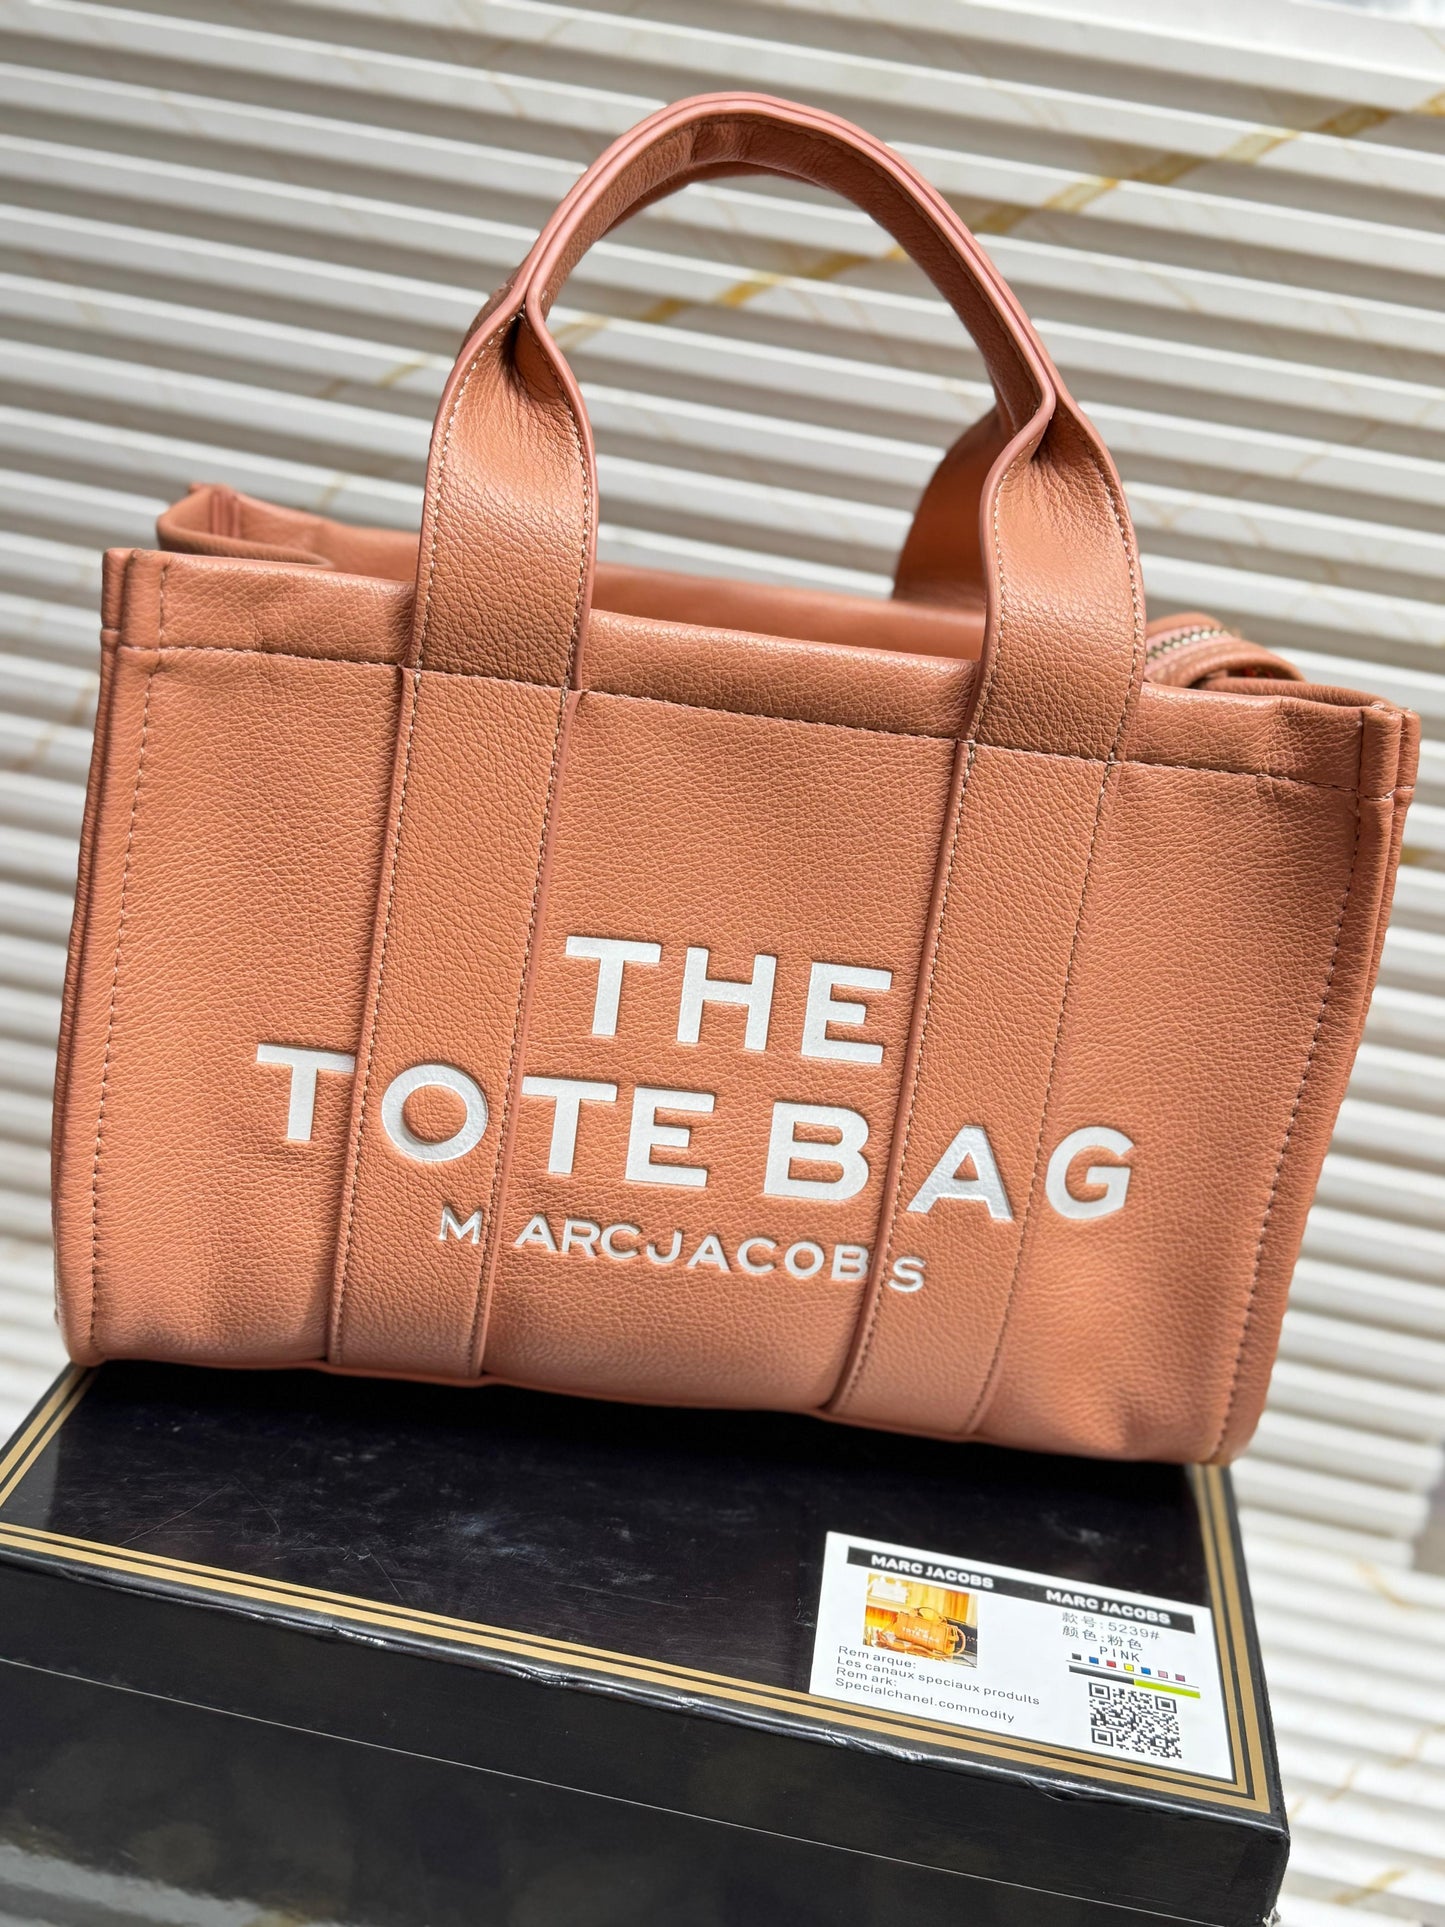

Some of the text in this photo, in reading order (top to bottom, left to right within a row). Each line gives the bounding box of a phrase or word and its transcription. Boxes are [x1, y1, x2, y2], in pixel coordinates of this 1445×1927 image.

[565, 935, 893, 1064] THE
[256, 1043, 1135, 1222] TOTE BAG
[871, 1554, 995, 1589] MARC JACOBS
[1045, 1589, 1172, 1625] MARC JACOBS
[1099, 1646, 1141, 1663] PINK
[837, 1656, 861, 1668] Les
[865, 1663, 915, 1680] canaux
[918, 1674, 980, 1694] speciaux
